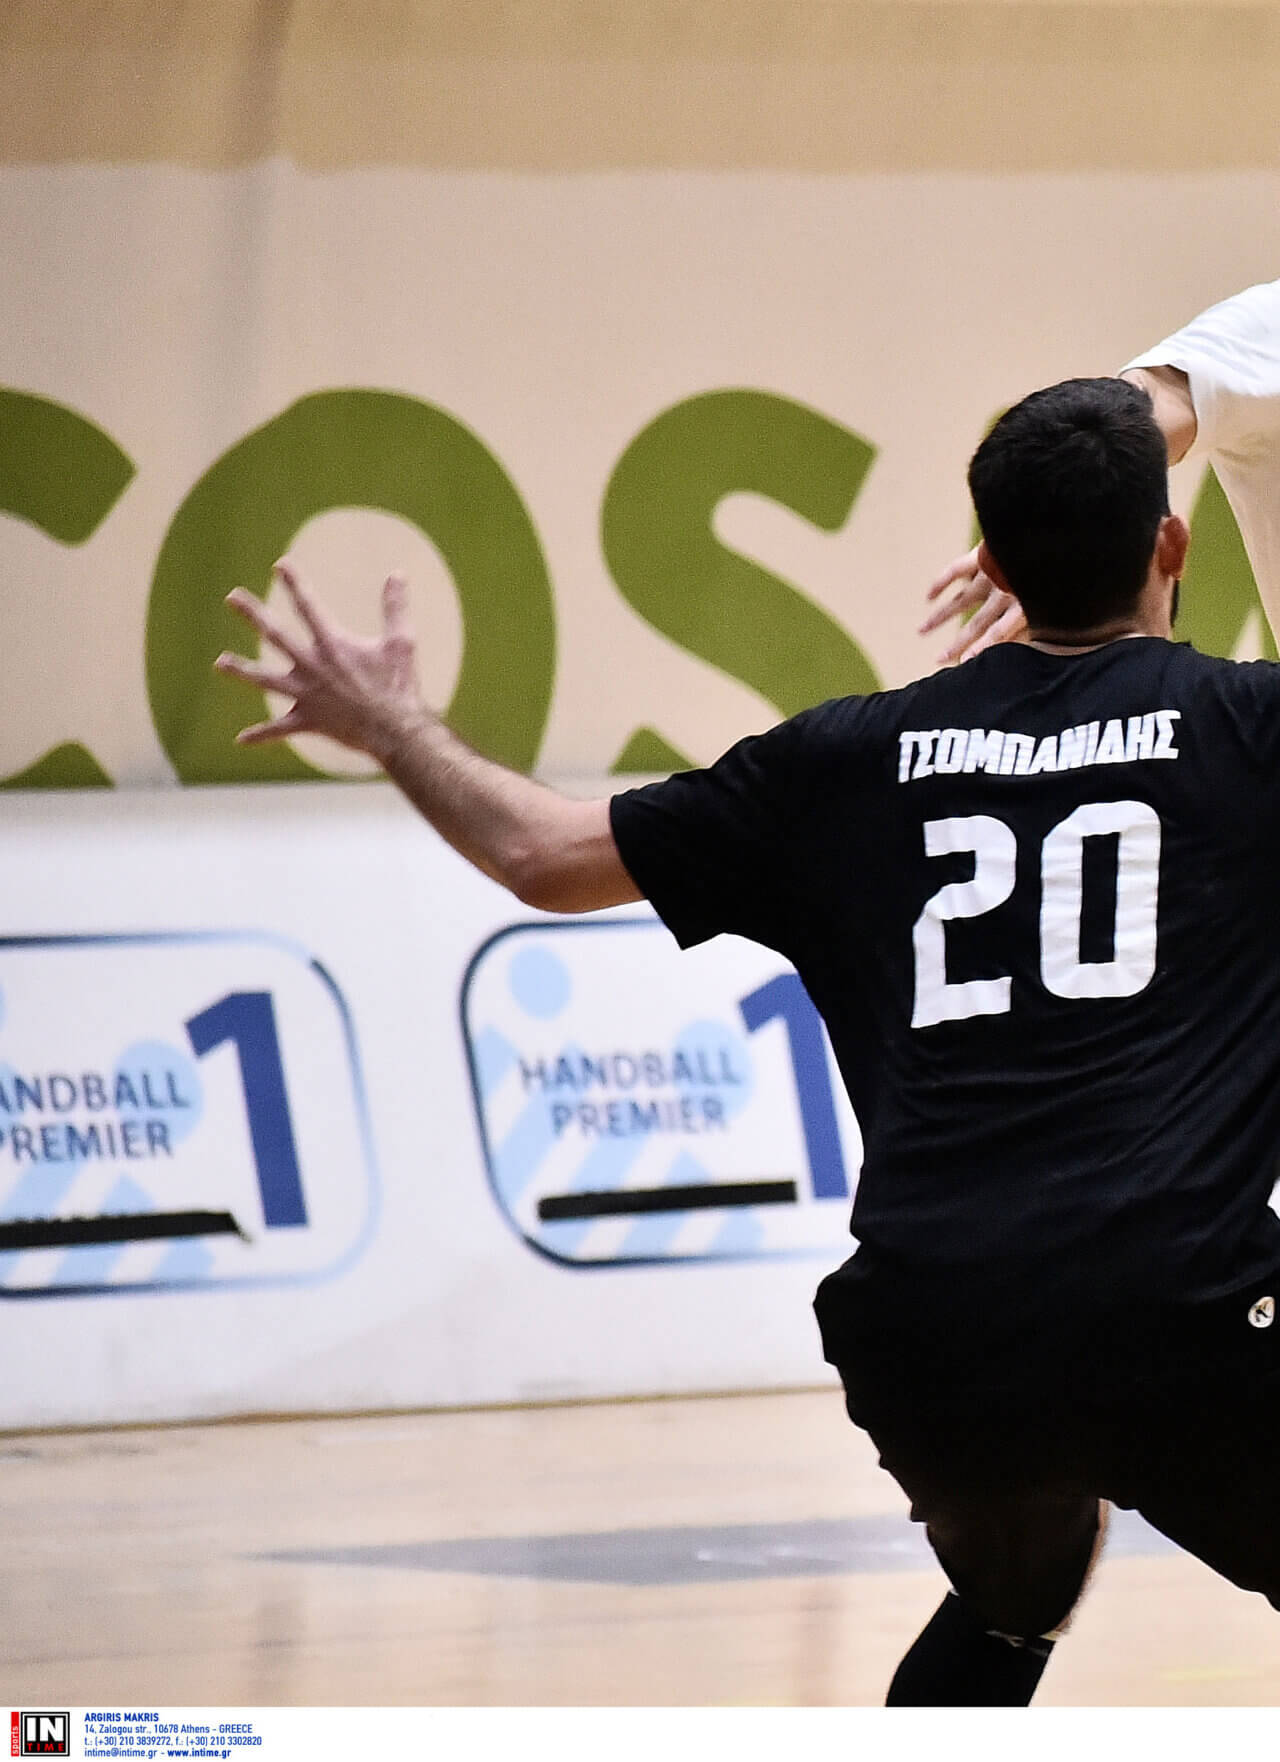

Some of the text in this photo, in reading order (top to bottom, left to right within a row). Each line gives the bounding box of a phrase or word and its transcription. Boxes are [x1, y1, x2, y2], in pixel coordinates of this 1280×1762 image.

[898, 709, 1181, 783] ΤΣΟΜΠΑΝΙΔΗΣ
[910, 800, 1162, 1029] 20
[519, 1050, 742, 1094] HANDBALL
[739, 973, 849, 1198] 1
[0, 1119, 173, 1164] REMIER
[183, 991, 309, 1228] 1
[552, 1096, 728, 1138] PREMIER
